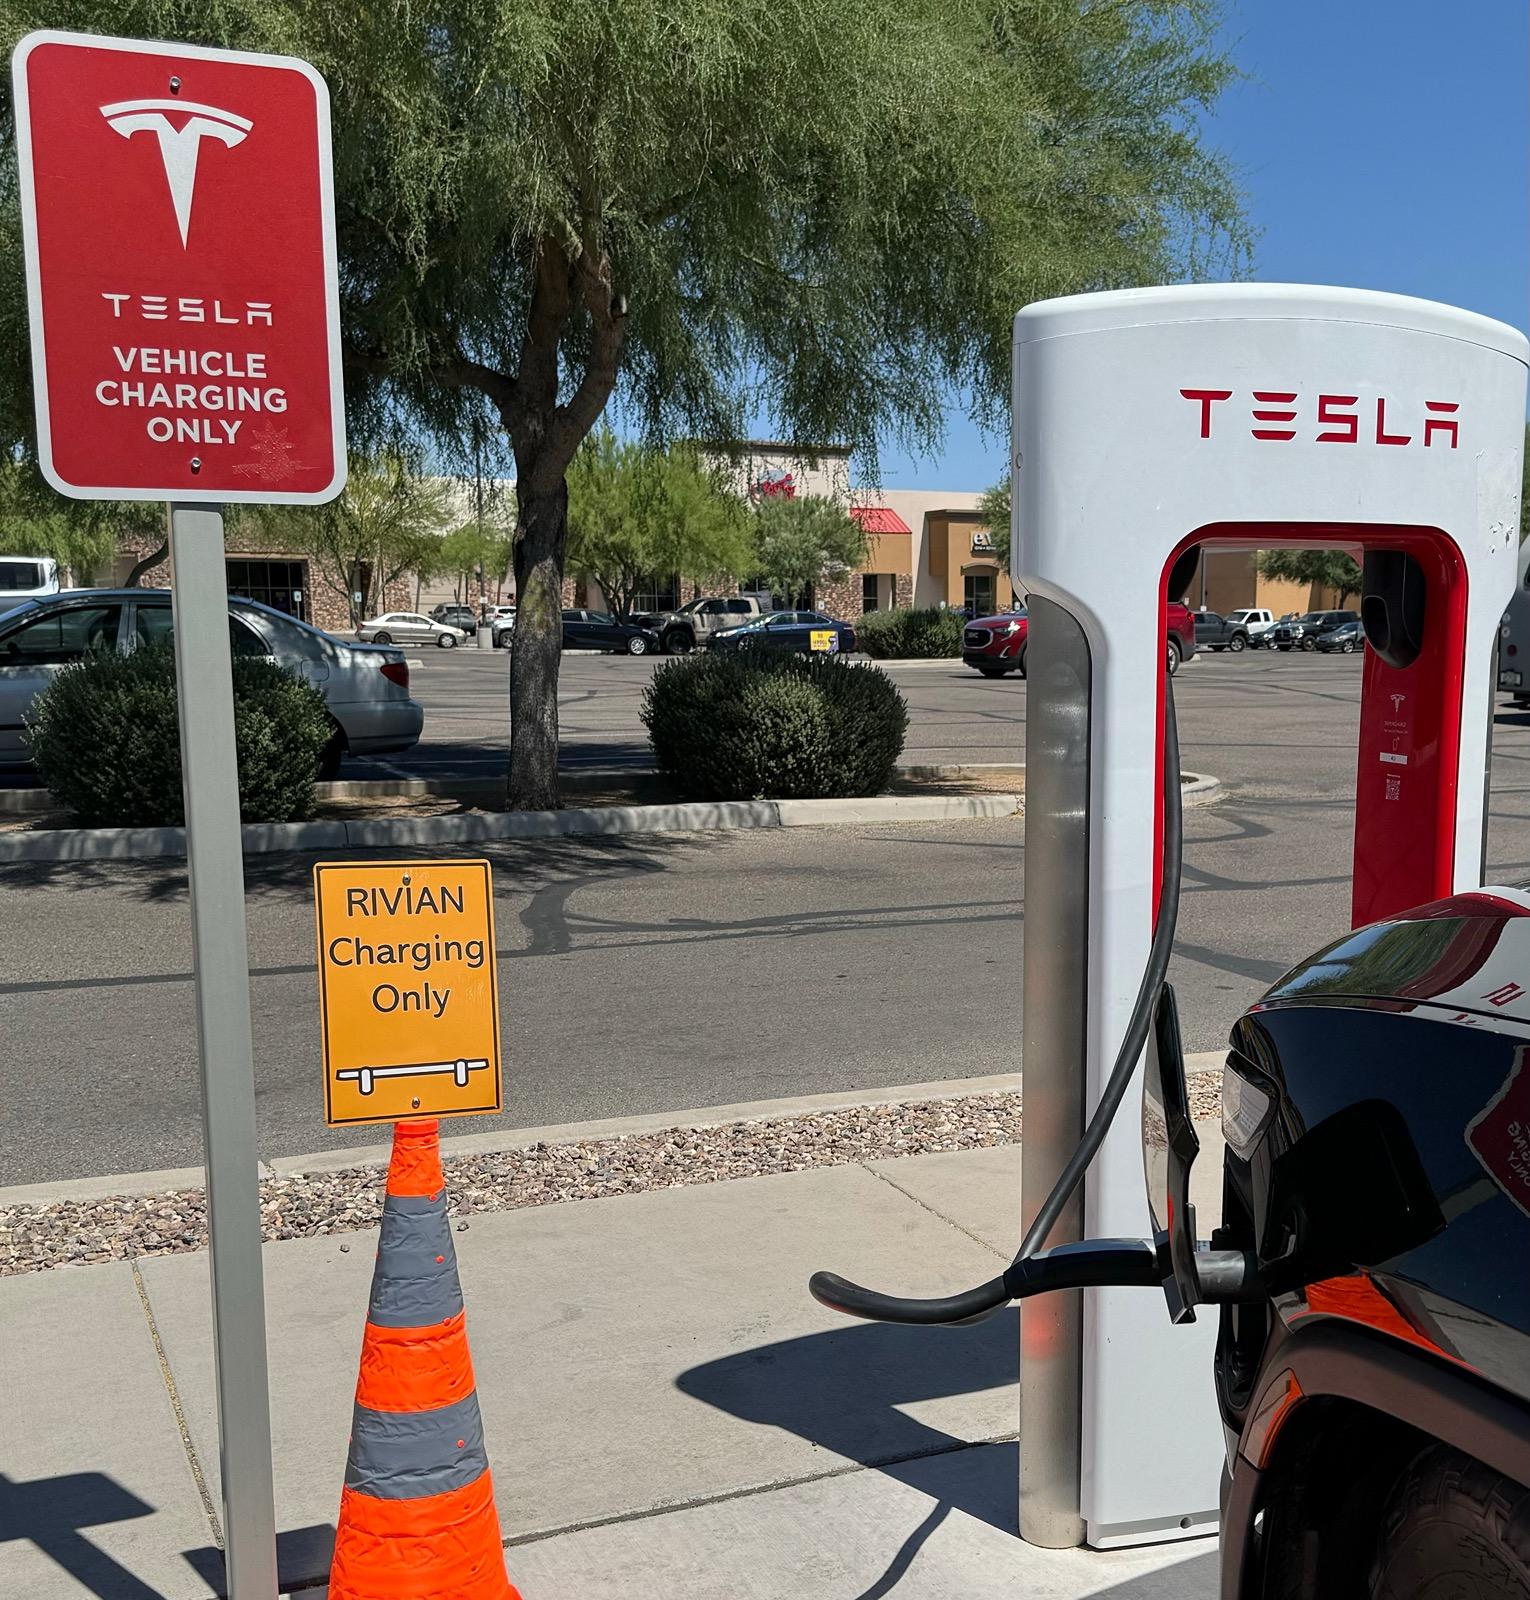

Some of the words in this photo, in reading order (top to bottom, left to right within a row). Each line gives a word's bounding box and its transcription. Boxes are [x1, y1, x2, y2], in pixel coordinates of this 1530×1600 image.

[102, 293, 273, 326] TESLA
[112, 346, 267, 380] VEHICLE
[95, 380, 288, 413] CHARGING
[146, 416, 243, 445] ONLY
[1180, 389, 1460, 449] TESLA
[347, 885, 464, 917] RIVIAN
[329, 934, 484, 971] Charging
[372, 982, 451, 1018] Only
